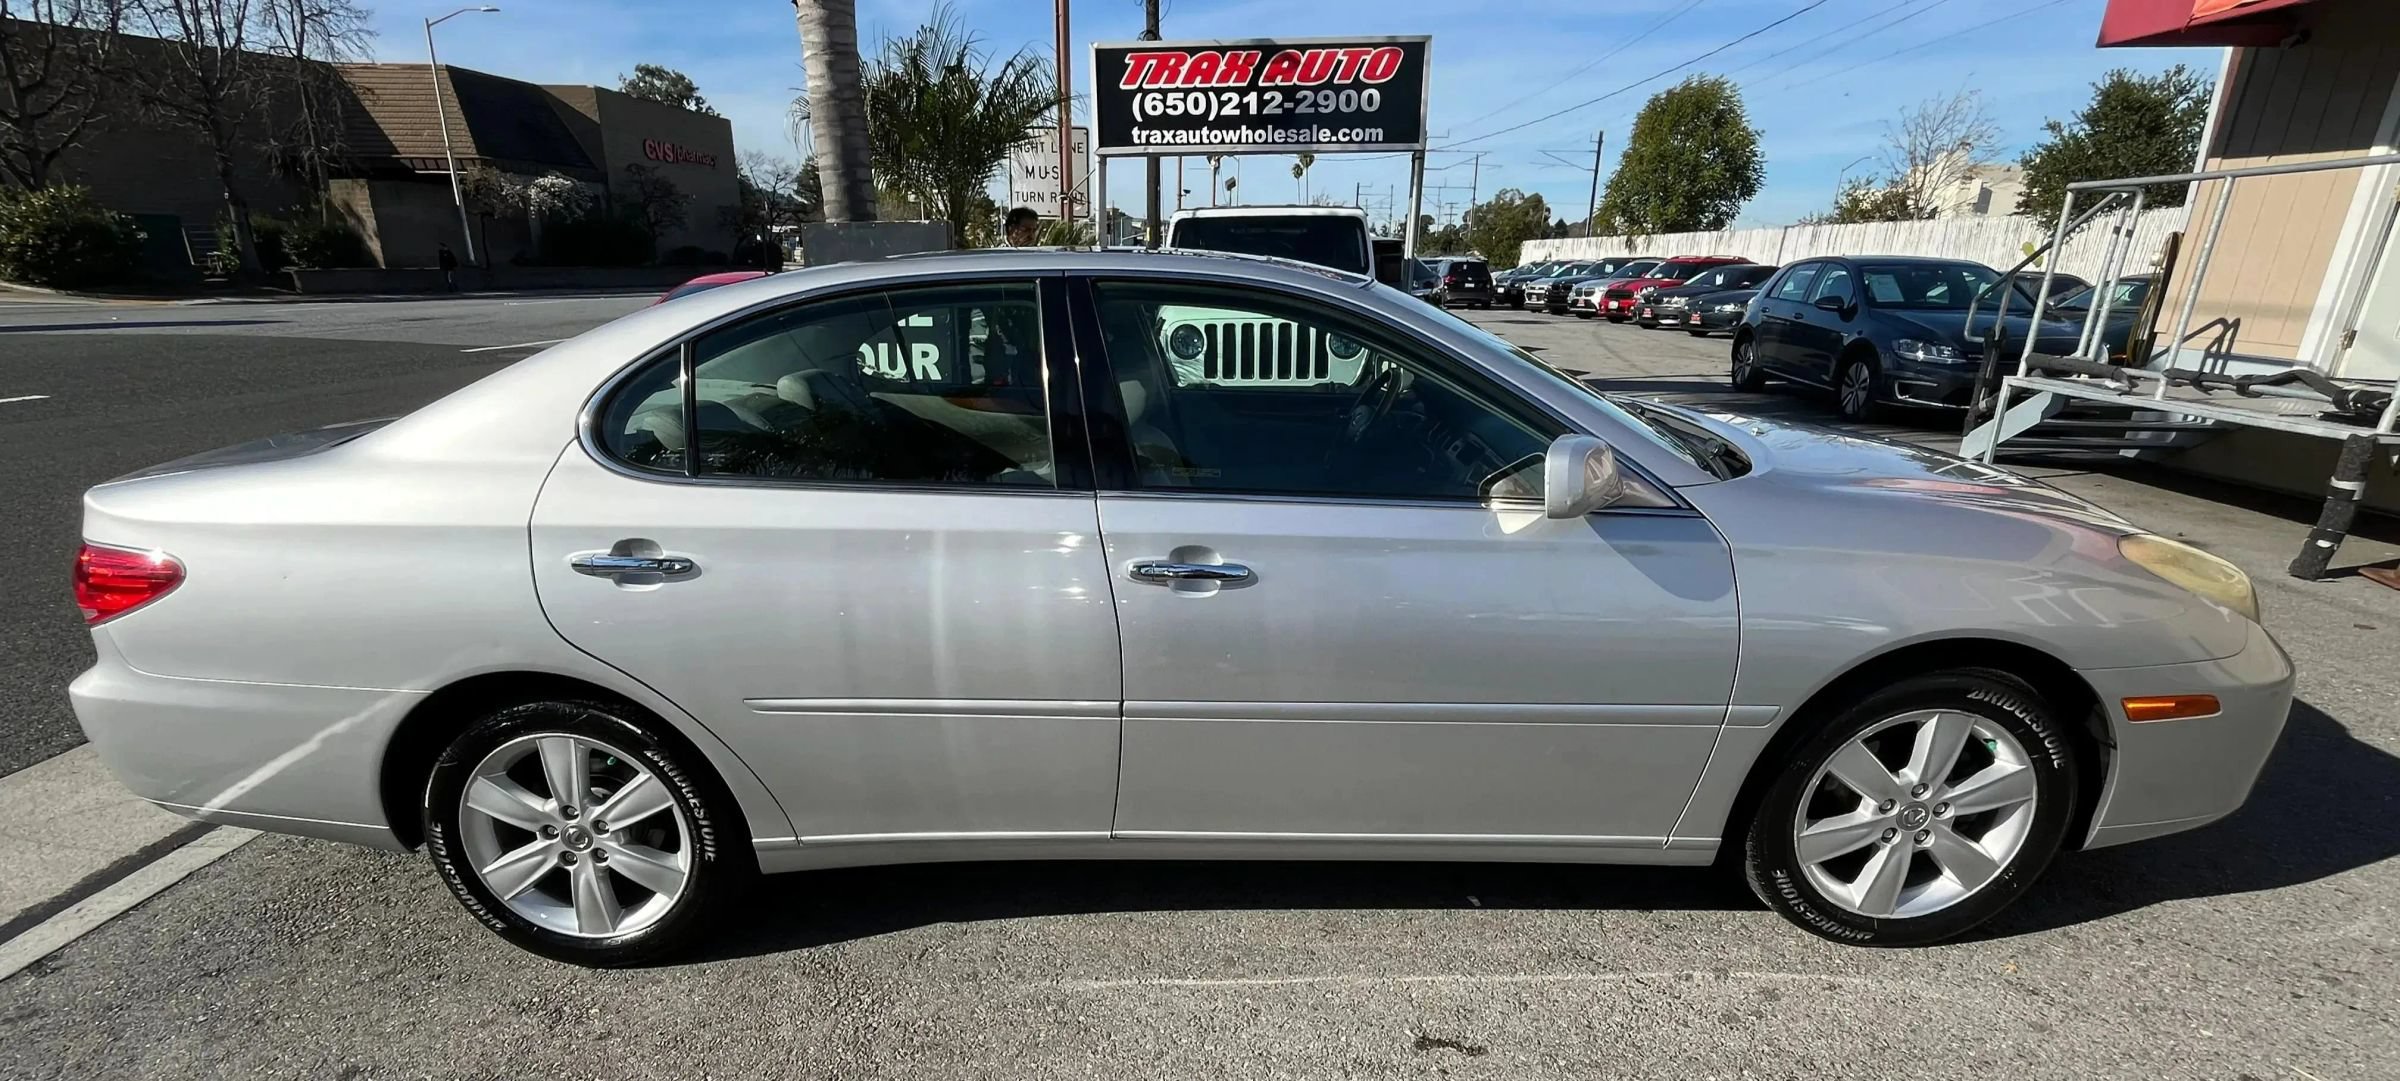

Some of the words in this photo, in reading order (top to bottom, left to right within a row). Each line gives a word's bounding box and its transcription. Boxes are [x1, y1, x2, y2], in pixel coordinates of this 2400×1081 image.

[1119, 50, 1261, 89] TRAX
[1259, 46, 1403, 86] AUTO
[1132, 88, 1380, 121] (650)212-2900
[1132, 124, 1383, 144] traxautowholesale.com
[1051, 142, 1084, 154] LNE
[1025, 165, 1060, 180] MUS
[1014, 191, 1045, 203] TURN
[1050, 191, 1085, 203] RHT
